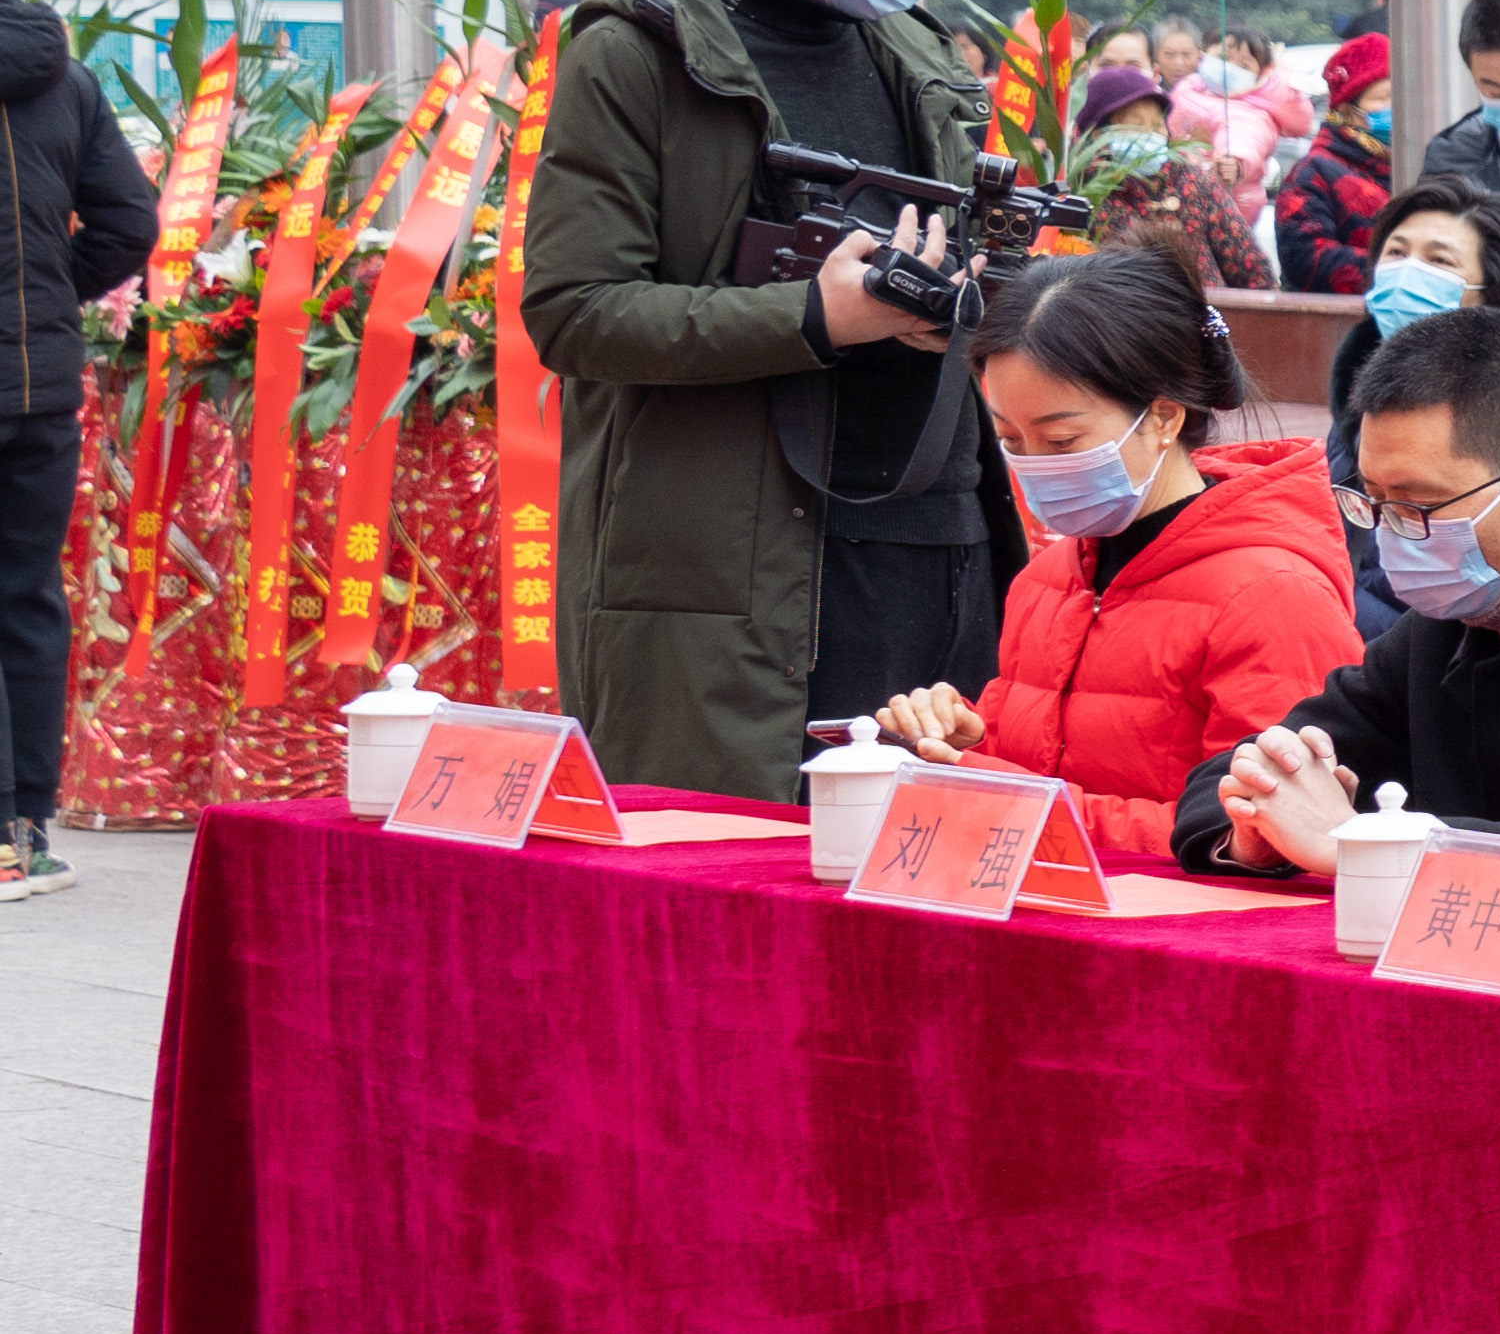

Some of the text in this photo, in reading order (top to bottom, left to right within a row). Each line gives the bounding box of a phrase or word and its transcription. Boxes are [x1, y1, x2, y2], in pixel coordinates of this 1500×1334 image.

[893, 274, 924, 295] SONY
[338, 522, 381, 619] 恭贺
[512, 503, 551, 644] 全家恭贺
